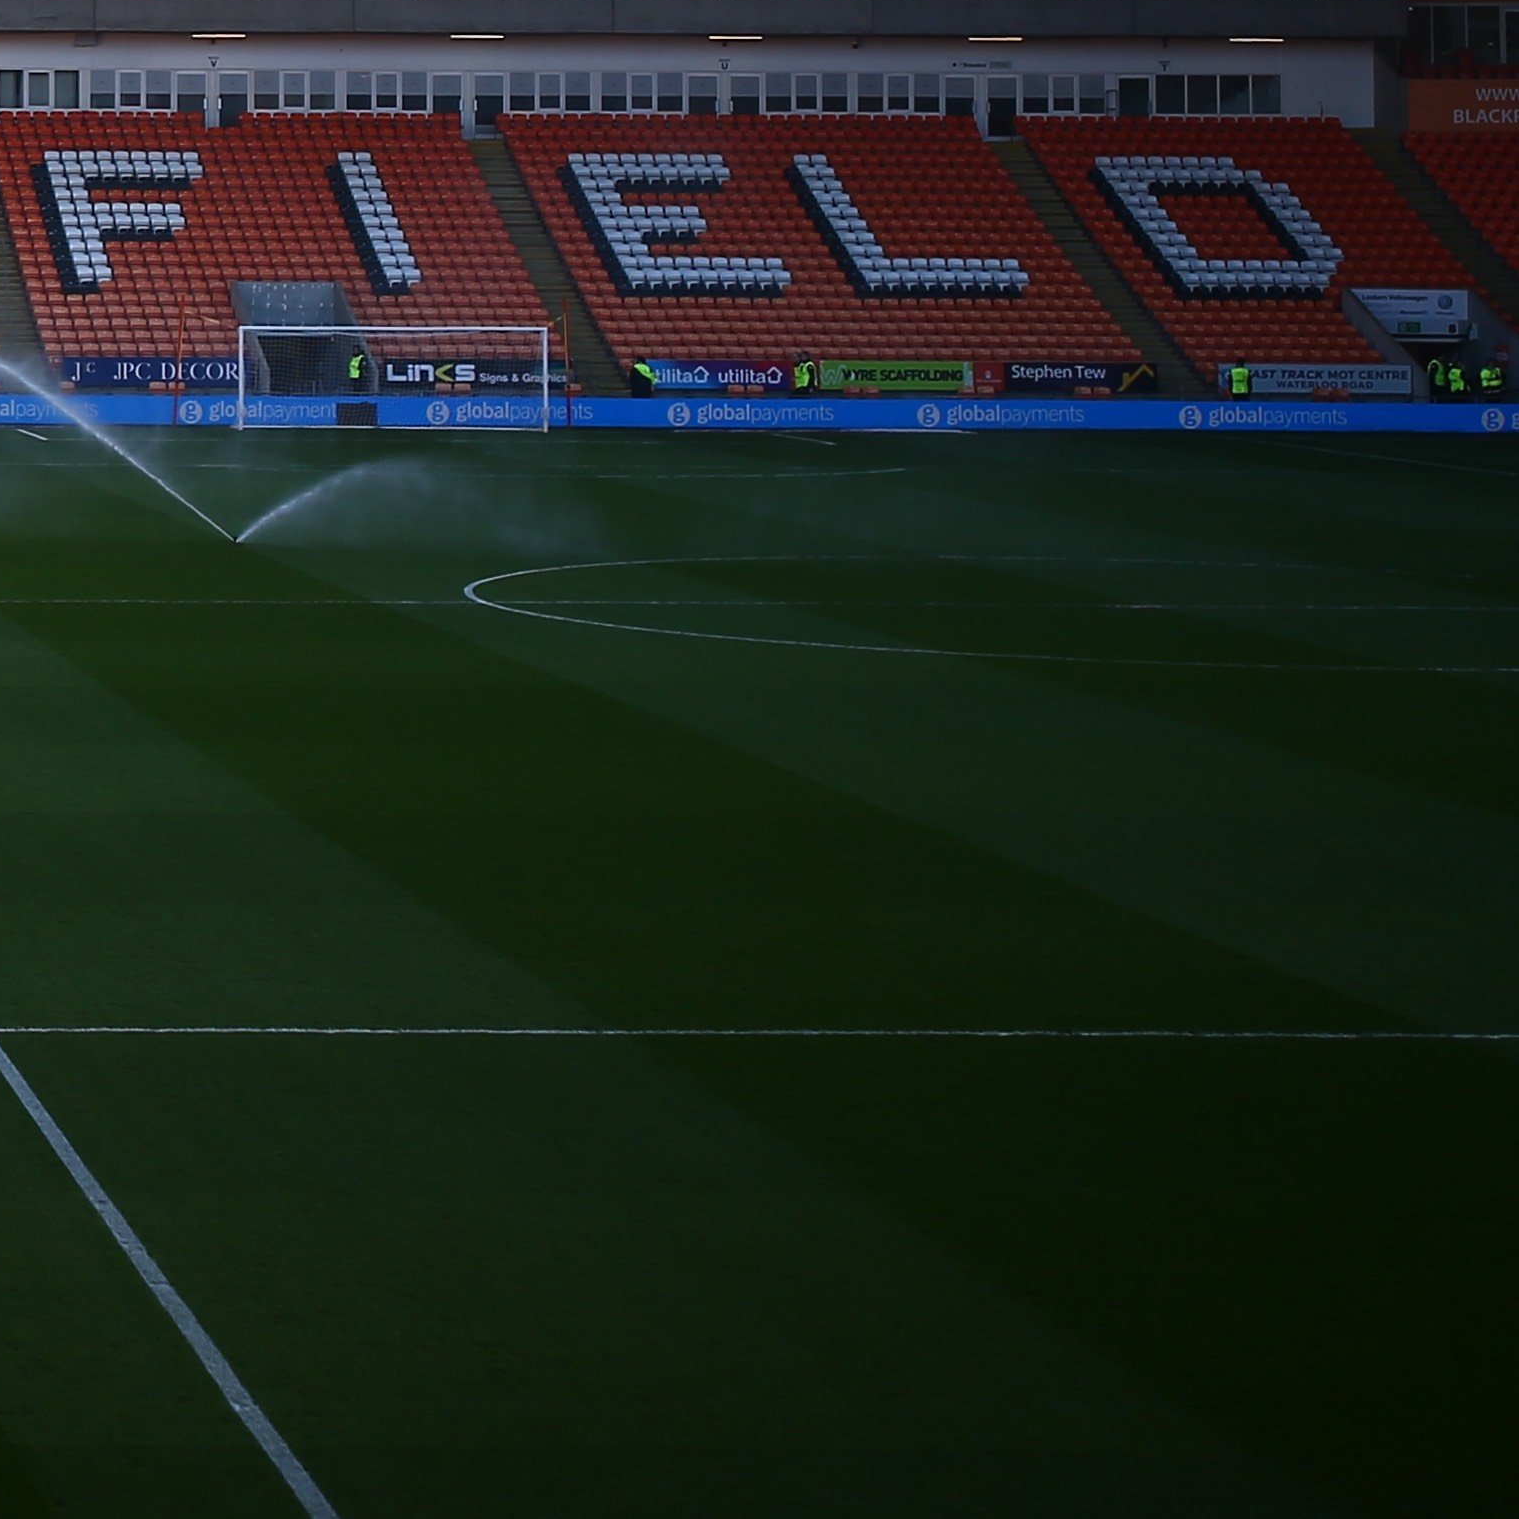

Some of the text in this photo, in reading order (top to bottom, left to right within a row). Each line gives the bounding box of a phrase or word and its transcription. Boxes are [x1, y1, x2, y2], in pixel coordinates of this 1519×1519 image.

[113, 362, 151, 381] JPC
[479, 372, 508, 384] Signs
[655, 367, 766, 384] tilita utilita
[843, 369, 962, 381] WYRE SCAFFOLDING
[1011, 364, 1107, 381] Stephen Tew
[1280, 370, 1323, 379] TRACK
[1328, 370, 1348, 379] MOT
[1352, 370, 1408, 380] CENTRE
[209, 400, 337, 421] gloalpayment
[697, 402, 834, 425] globalpayments
[947, 403, 1085, 425] globalpayments
[1209, 405, 1348, 428] globalpayments
